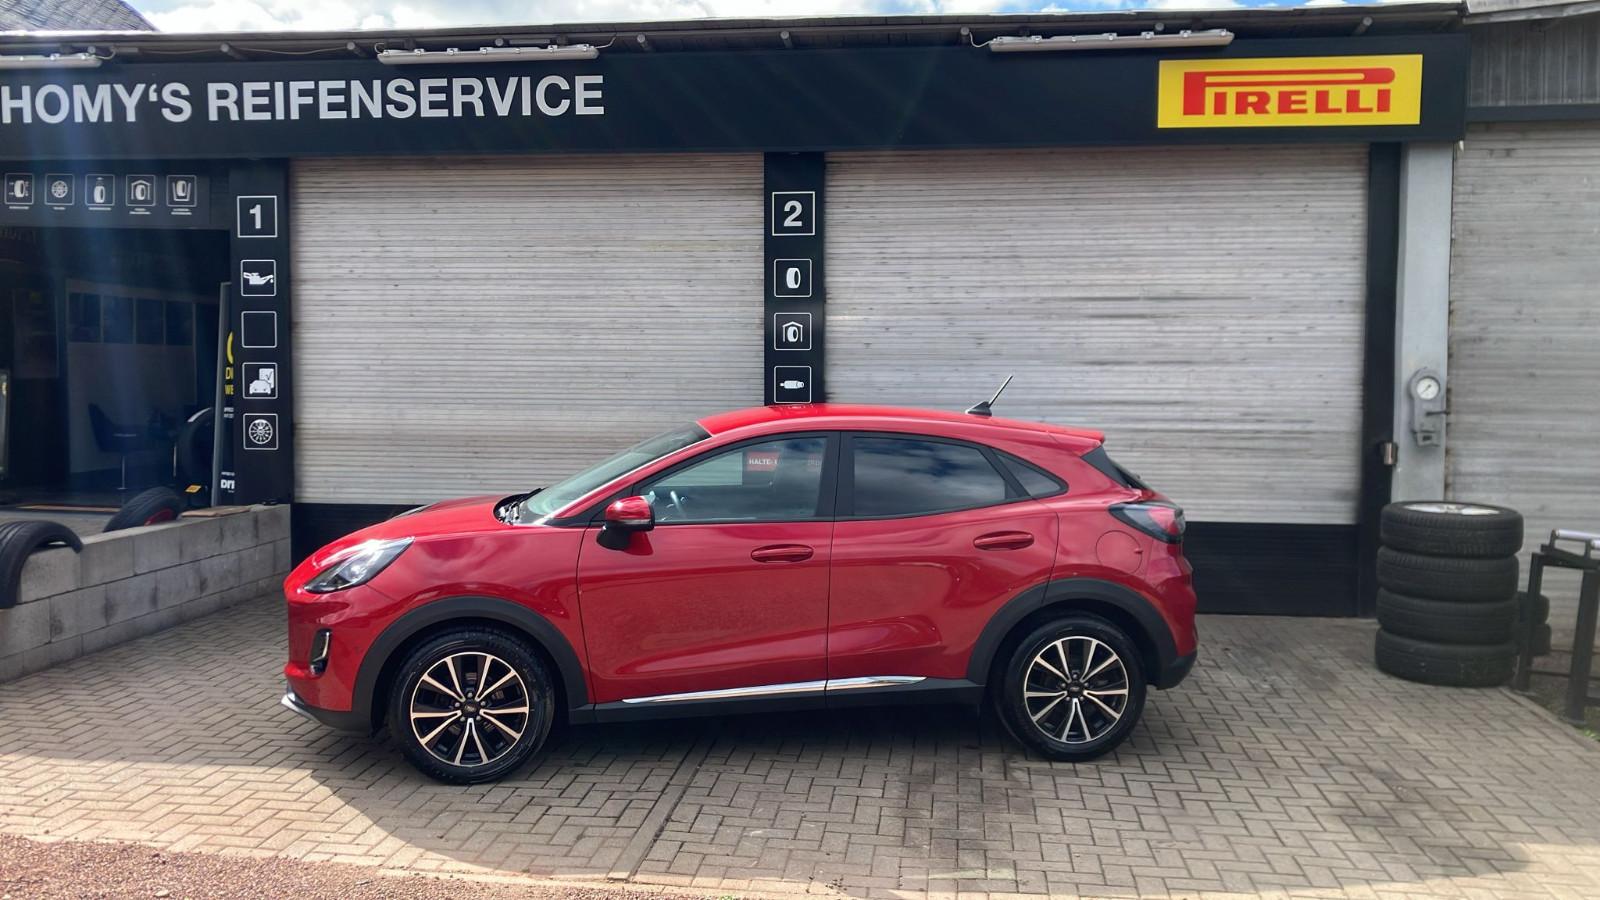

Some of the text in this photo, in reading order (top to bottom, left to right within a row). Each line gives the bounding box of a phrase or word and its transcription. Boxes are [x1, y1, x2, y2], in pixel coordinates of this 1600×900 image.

[208, 76, 605, 121] REIFENSERVICE
[1183, 68, 1394, 116] PIRELLI
[250, 205, 262, 229] 1
[783, 201, 803, 227] 2
